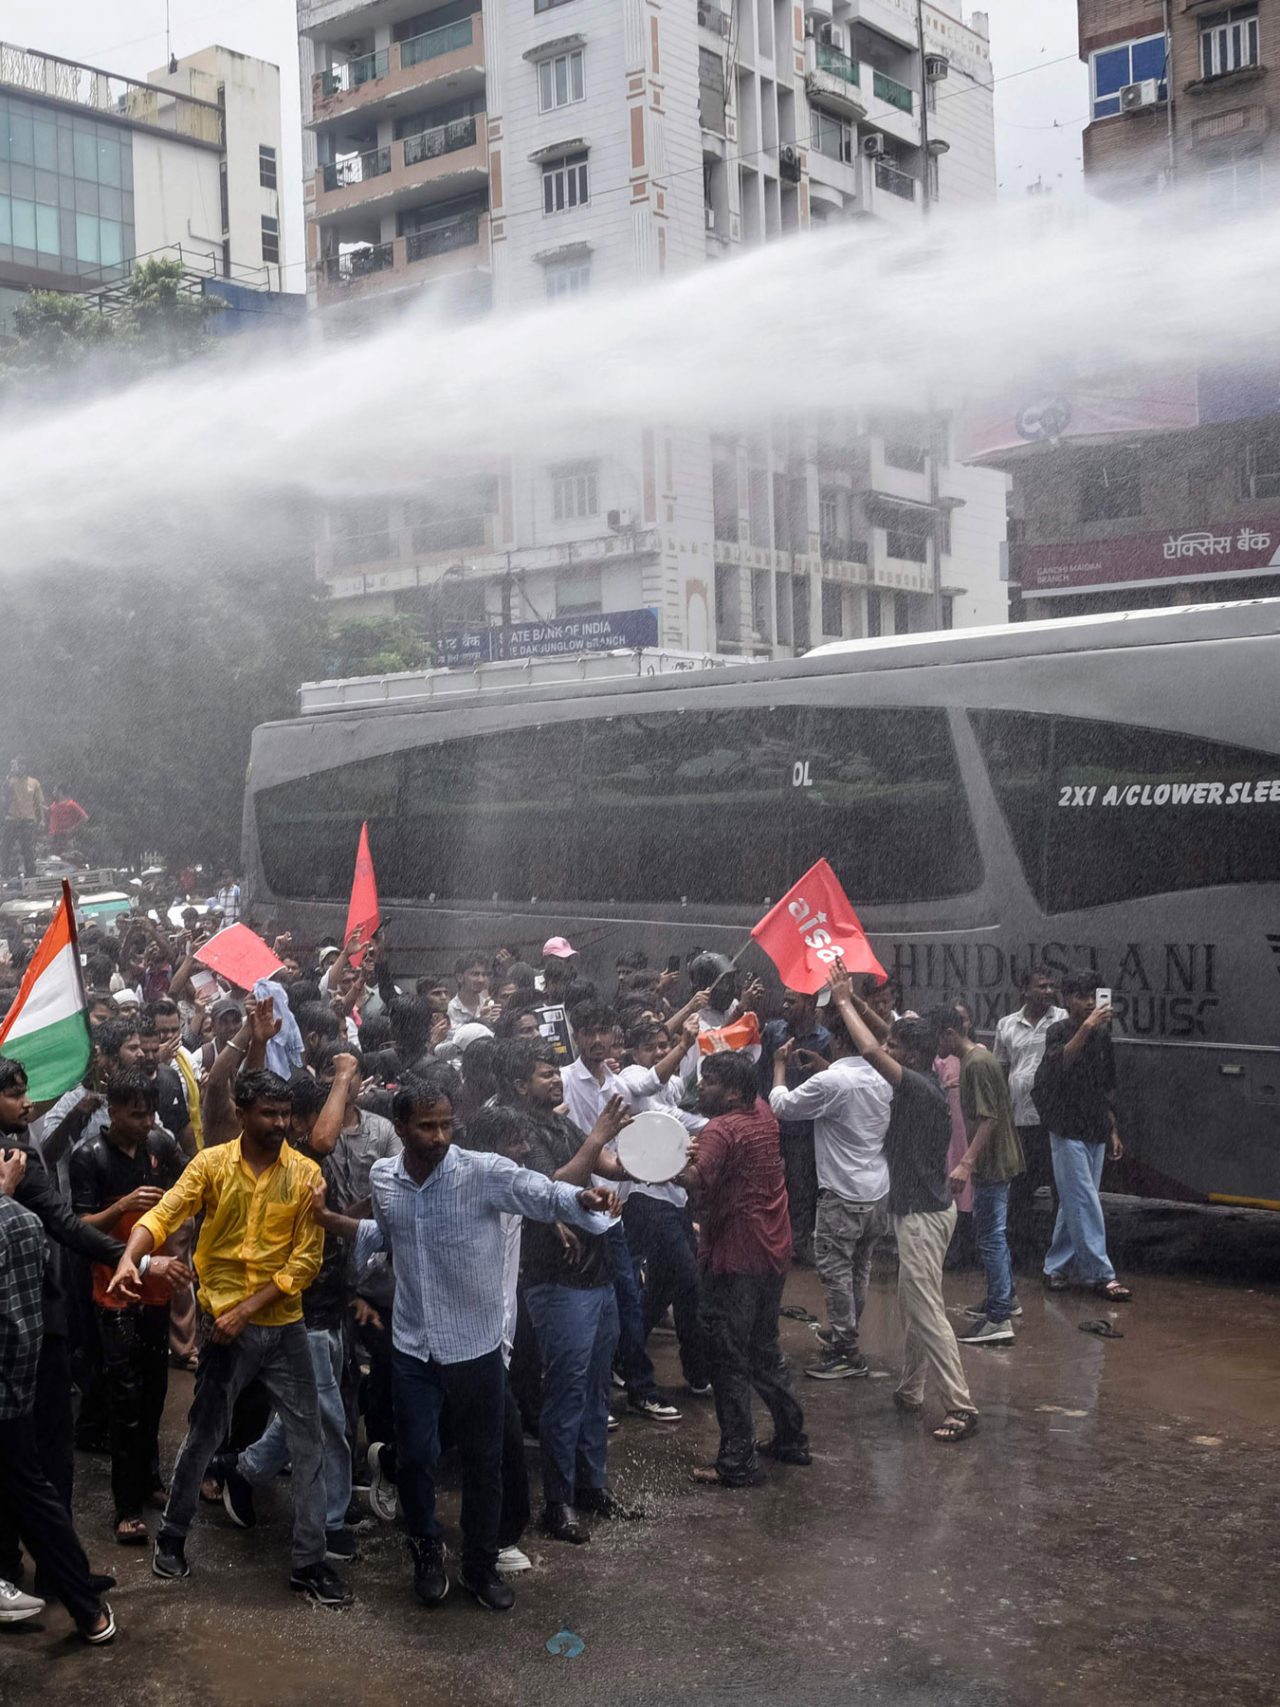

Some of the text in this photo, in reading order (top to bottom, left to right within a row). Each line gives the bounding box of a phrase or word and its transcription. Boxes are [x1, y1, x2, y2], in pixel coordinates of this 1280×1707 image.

[1237, 528, 1271, 551] बैंक
[499, 629, 530, 645] SATE
[533, 626, 563, 641] BANK
[582, 621, 611, 635] INDIA
[1058, 786, 1097, 806] 2X1
[788, 897, 845, 964] aisa
